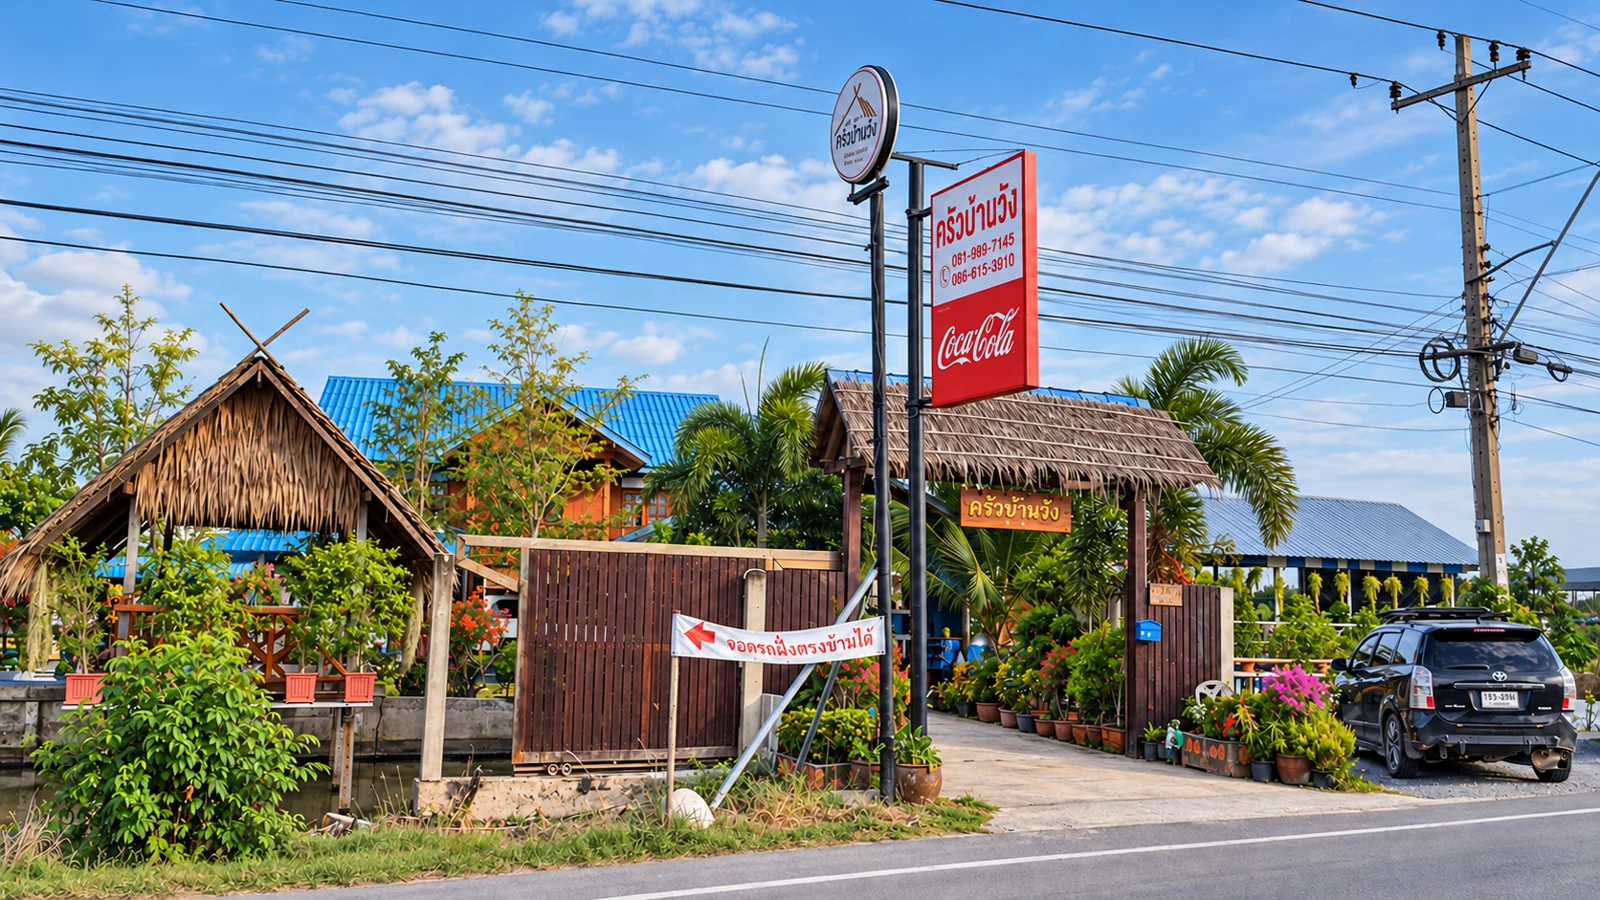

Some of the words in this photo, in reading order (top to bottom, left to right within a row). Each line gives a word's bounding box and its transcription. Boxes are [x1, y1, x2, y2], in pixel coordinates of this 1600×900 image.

[936, 182, 1017, 249] ครัวบ้านวัง
[952, 231, 1015, 268] 081-989-7145
[952, 252, 1015, 287] 086-615-3910
[969, 494, 1059, 521] ครัวบ้านวัง
[726, 625, 875, 657] จอดรถฝั่งตรงข้ามได้
